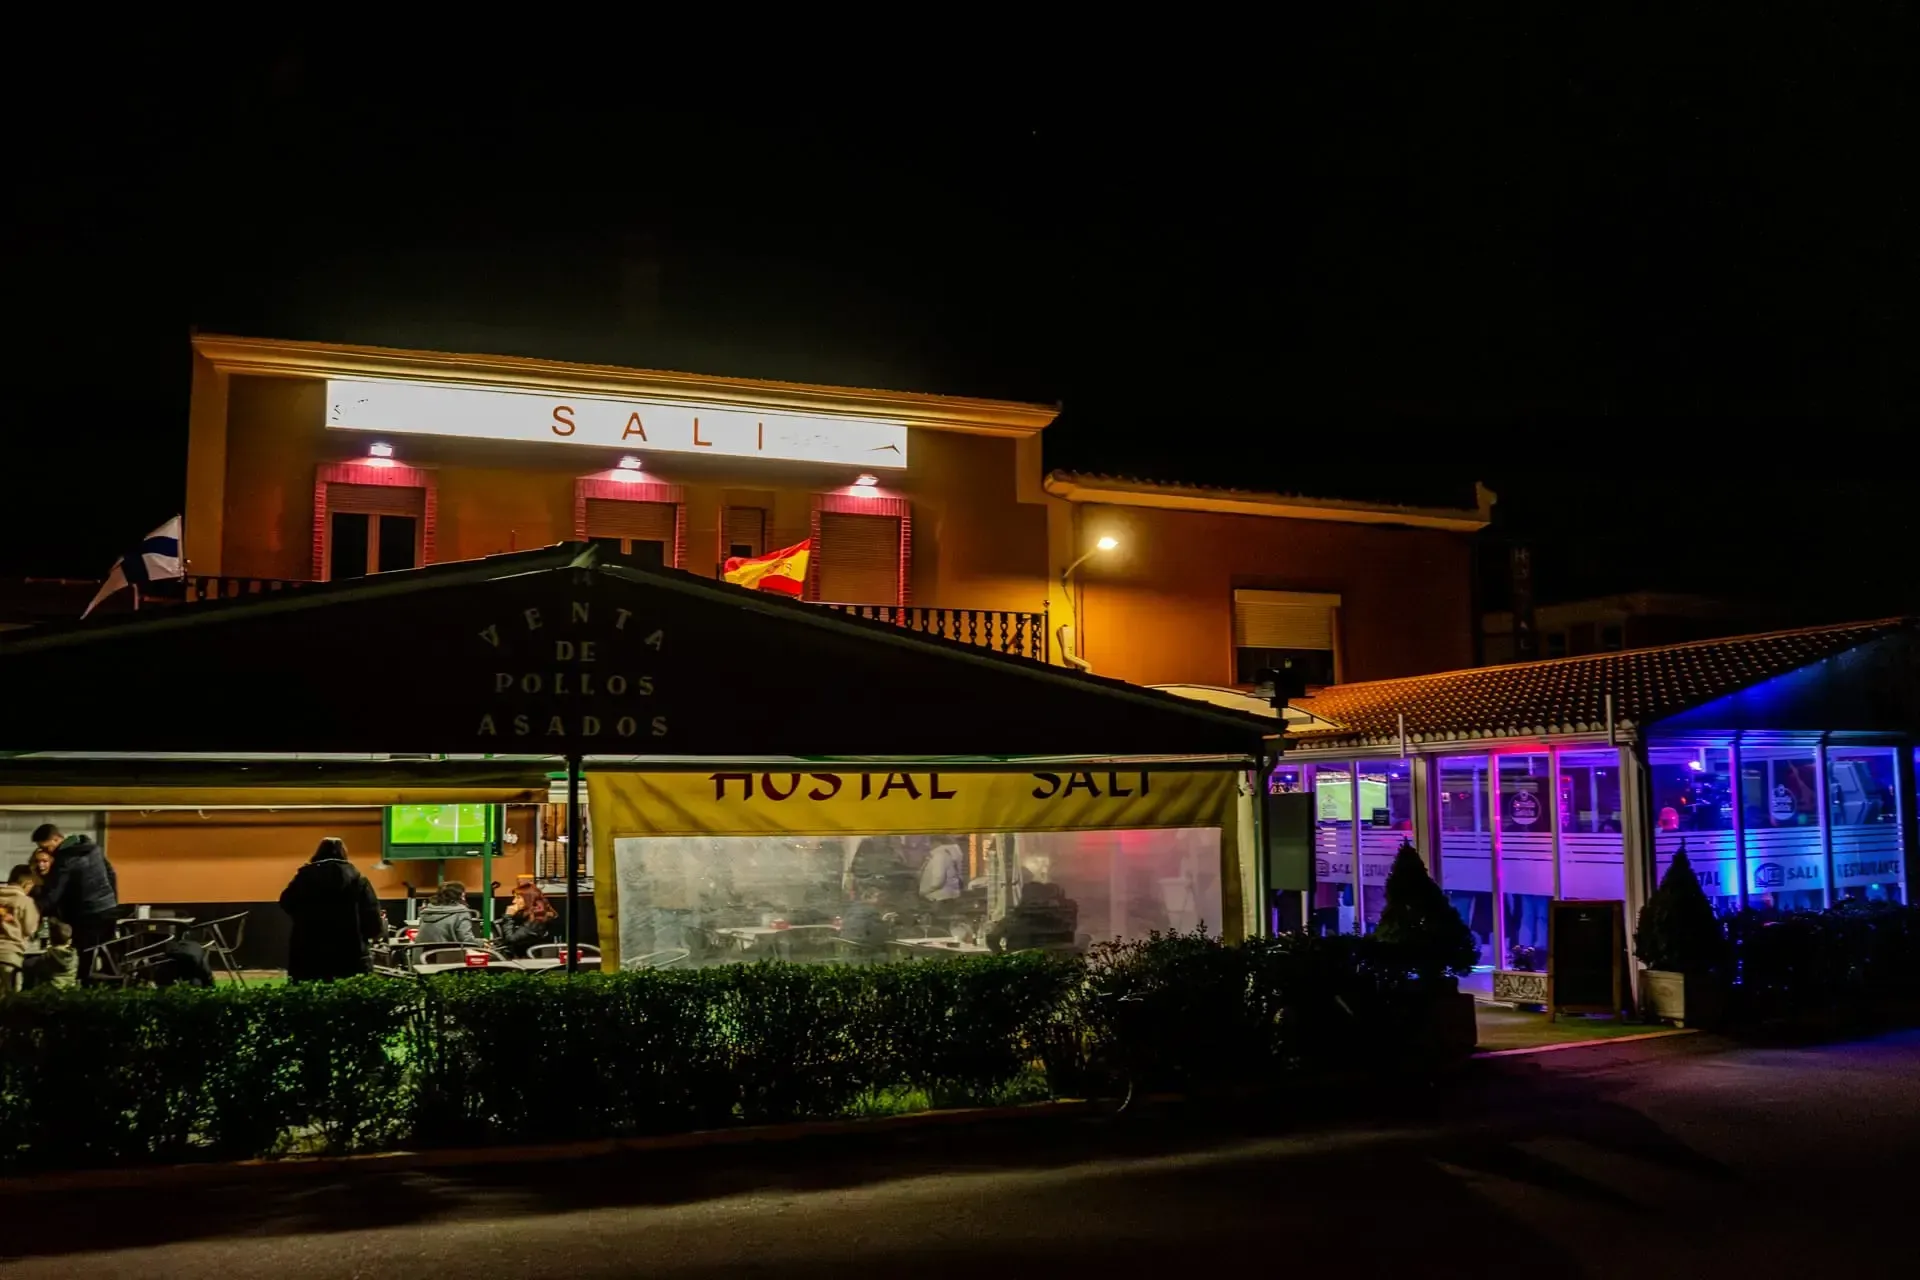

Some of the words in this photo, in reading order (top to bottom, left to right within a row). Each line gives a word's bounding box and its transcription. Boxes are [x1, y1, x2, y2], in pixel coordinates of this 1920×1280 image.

[551, 405, 763, 450] SALI
[478, 601, 665, 651] VENTA
[555, 641, 597, 662] DE
[494, 673, 655, 695] POLLOS
[476, 713, 669, 737] ASADOS
[708, 772, 958, 801] HOSTAL
[1786, 865, 1819, 880] SALI
